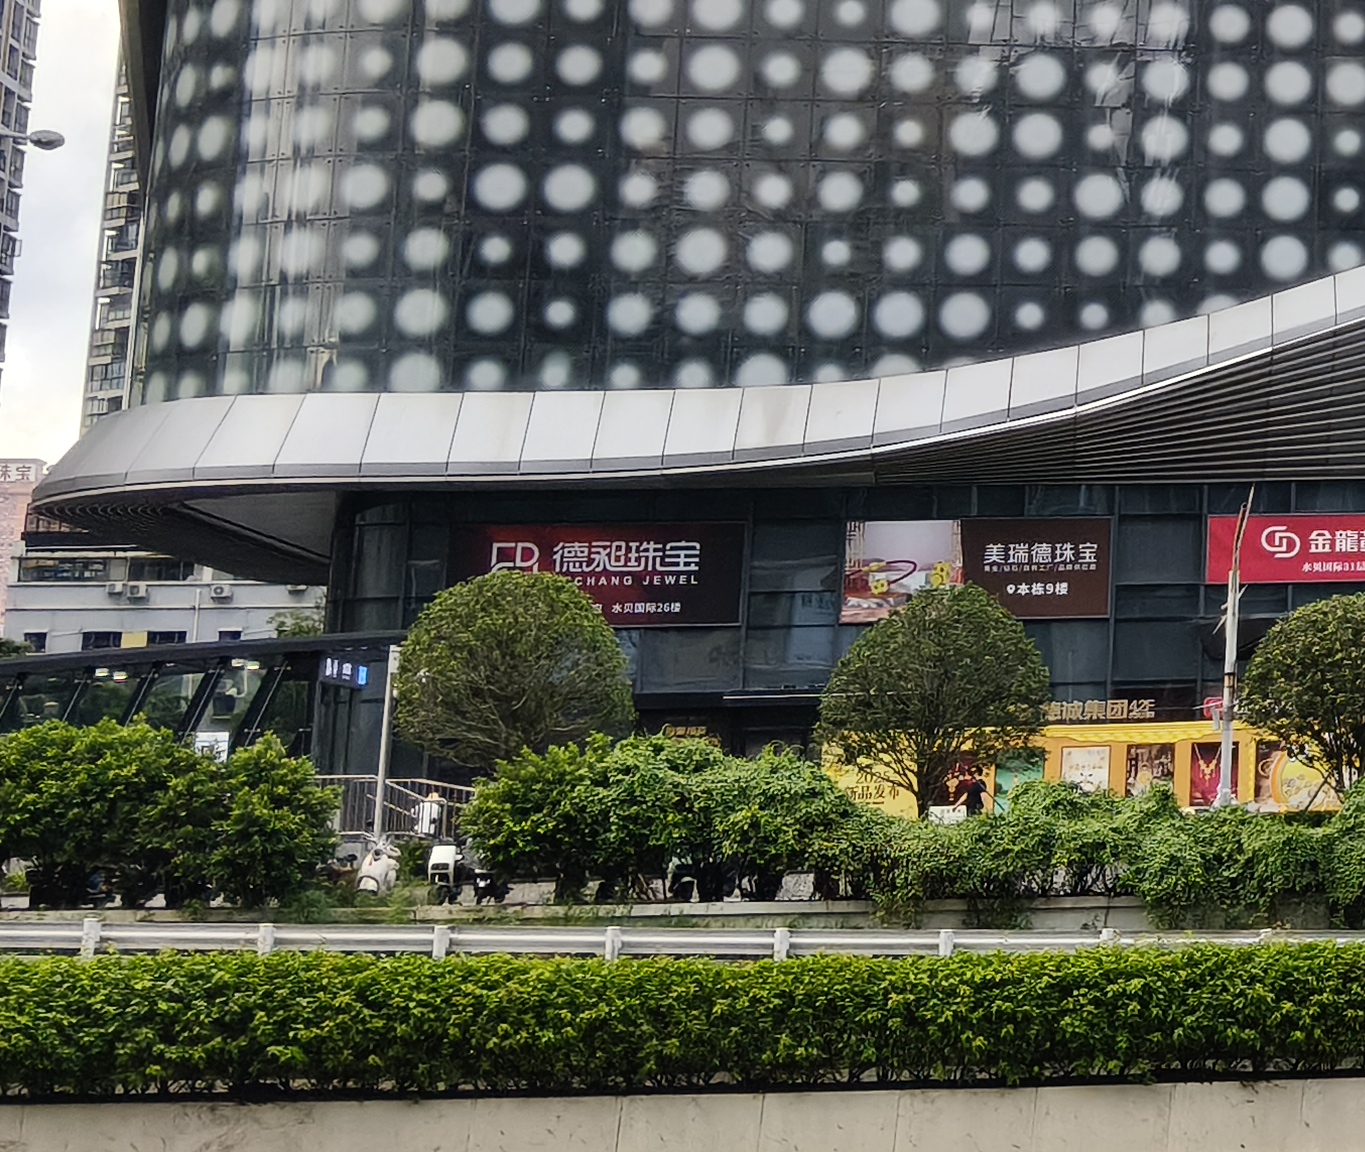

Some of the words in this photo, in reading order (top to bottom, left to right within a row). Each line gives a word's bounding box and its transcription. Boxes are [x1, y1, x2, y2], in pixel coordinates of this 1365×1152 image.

[983, 542, 1098, 563] 美瑞德珠宝
[573, 575, 632, 586] CHANG
[643, 573, 699, 585] JEWEL
[1016, 582, 1068, 595] 本栋9楼
[611, 602, 681, 614] 水贝国际26楼
